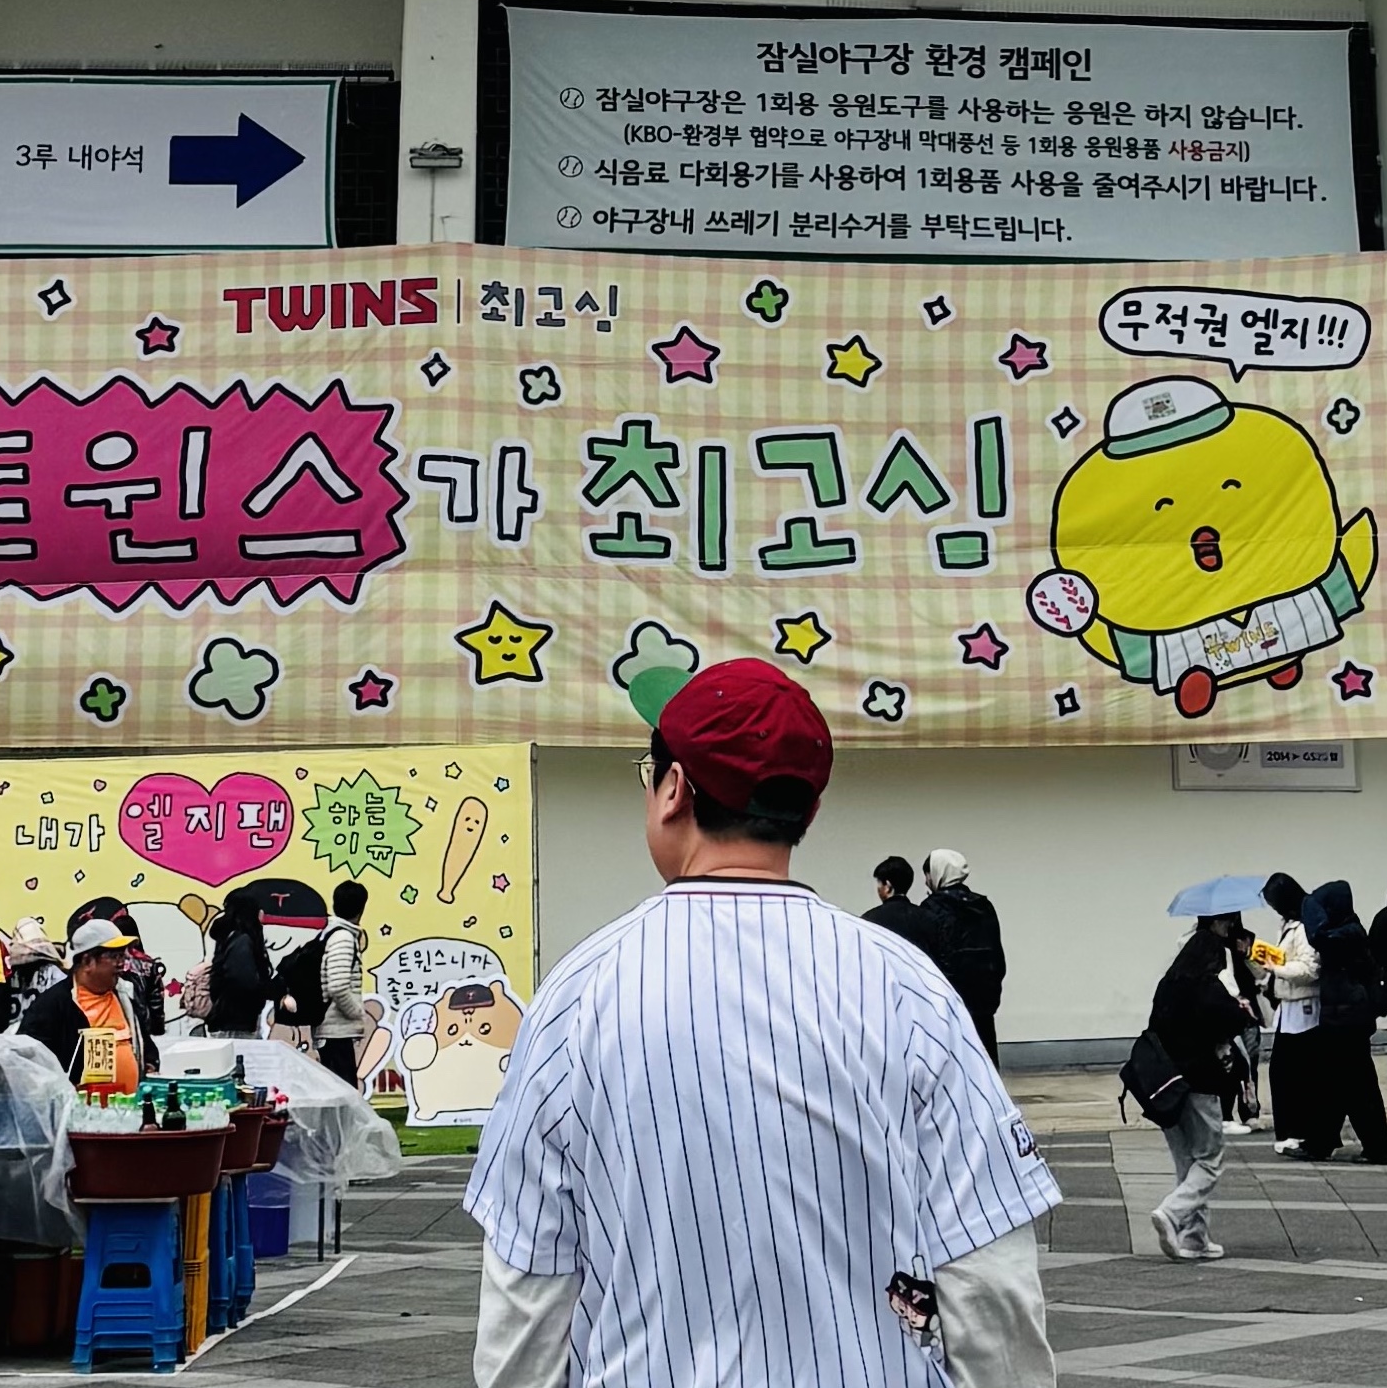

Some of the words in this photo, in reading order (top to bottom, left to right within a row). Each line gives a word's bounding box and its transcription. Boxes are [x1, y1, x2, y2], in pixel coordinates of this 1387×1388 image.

[756, 41, 914, 75] 잠실야구장
[924, 43, 987, 79] 환경
[999, 46, 1092, 82] 캠페인
[595, 86, 746, 114] 잠실야구장은
[756, 91, 819, 117] 1회용
[828, 93, 949, 121] 응원도구를
[958, 97, 1055, 125] 사용하는
[1063, 100, 1136, 126] 응원은
[1144, 103, 1192, 129] 하지
[1201, 105, 1303, 130] 않습니다.
[14, 143, 59, 173] 3루
[67, 143, 146, 175] 내야석
[624, 123, 742, 147] (KBO-환경부
[750, 126, 828, 149] 협약으로
[834, 128, 911, 152] 야구장내
[918, 130, 994, 155] 막대풍선
[1000, 134, 1021, 156] 등
[1028, 135, 1077, 158] 1회용
[1084, 136, 1161, 159] 응원용품
[1168, 139, 1250, 163] 사용금지)
[594, 159, 670, 186] 식음료
[679, 160, 804, 189] 다회용기를
[809, 164, 906, 191] 사용하여
[917, 167, 1002, 194] 1회용품
[1011, 169, 1084, 198] 사용을
[1092, 172, 1210, 201] 줄여주시기
[1220, 175, 1327, 203] 바랍니다.
[593, 206, 695, 235] 야구장내
[704, 210, 779, 237] 쓰레기
[789, 211, 912, 240] 분리수거를
[920, 213, 1072, 243] 부탁드립니다.
[223, 277, 438, 333] TWINS
[480, 280, 619, 333] 최고심
[1117, 300, 1228, 348] 무적권
[1240, 307, 1350, 356] 엘지!!!
[582, 415, 1007, 572] 최고심
[328, 792, 386, 827] 하는
[15, 813, 106, 852] 내가
[334, 830, 393, 861] 이유
[397, 949, 493, 973] 트윈스니까
